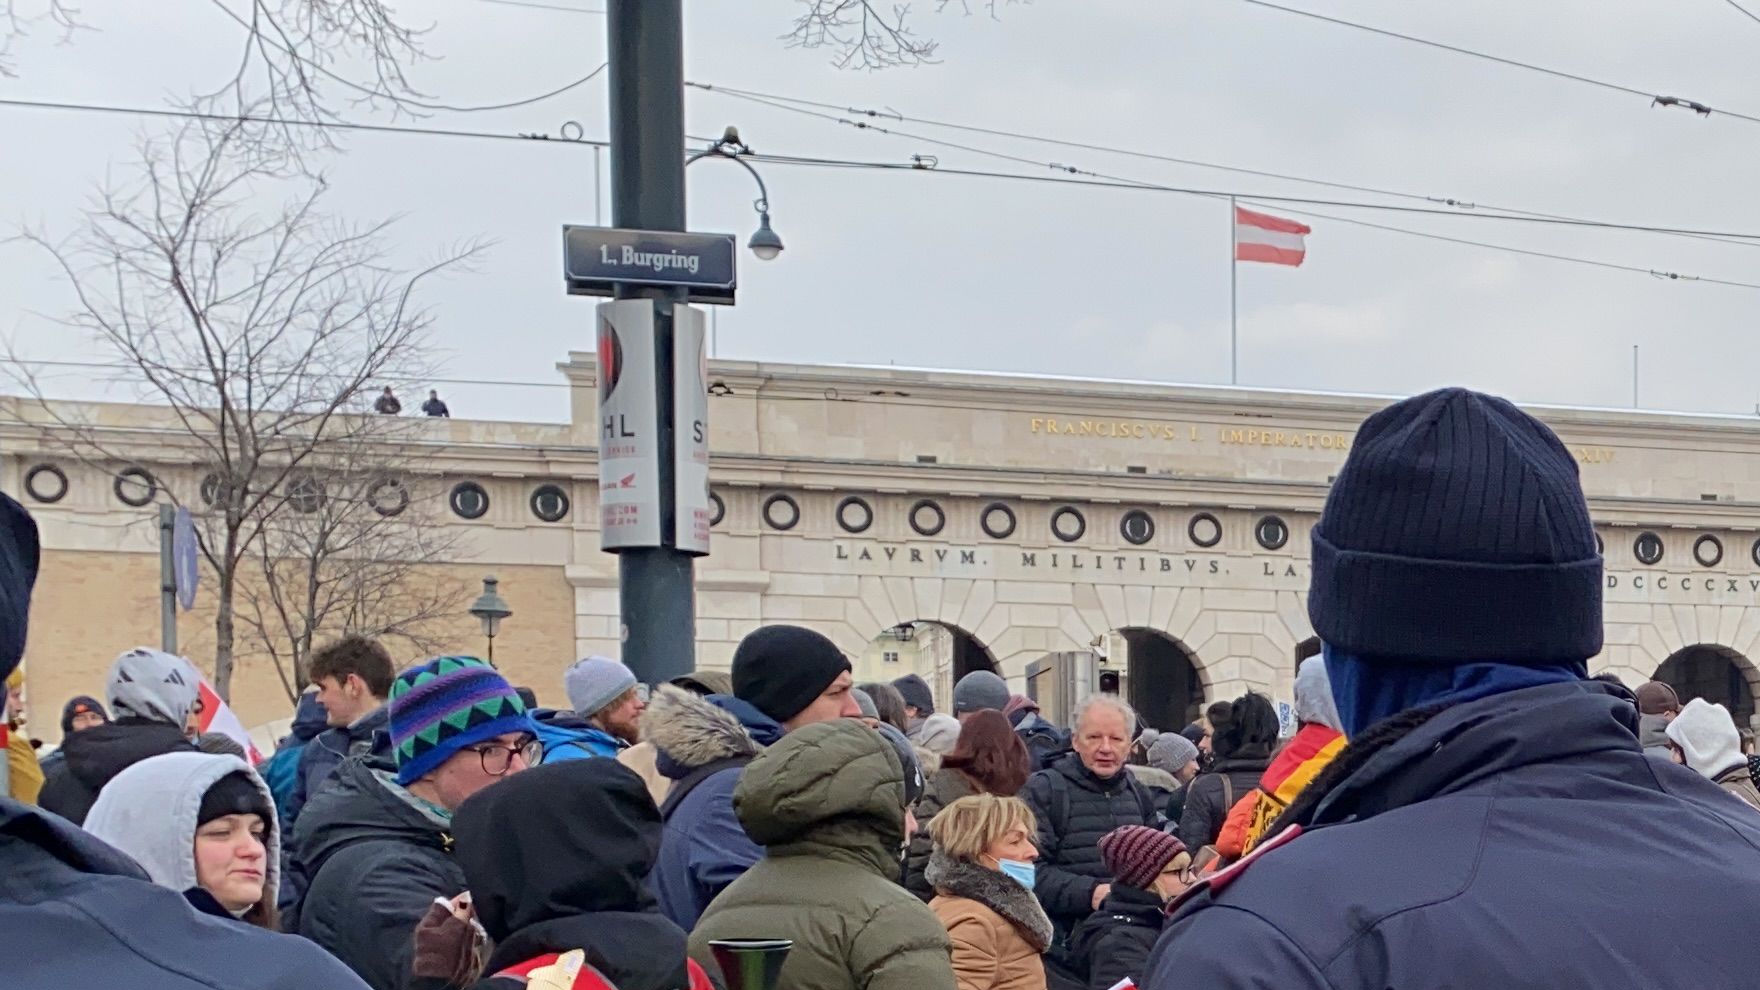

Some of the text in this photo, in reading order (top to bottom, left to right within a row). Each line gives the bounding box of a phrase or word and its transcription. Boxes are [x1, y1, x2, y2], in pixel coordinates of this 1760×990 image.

[621, 245, 699, 275] Burgring
[1031, 417, 1176, 440] FRANCISCVS
[1220, 429, 1348, 450] IMPERATOR
